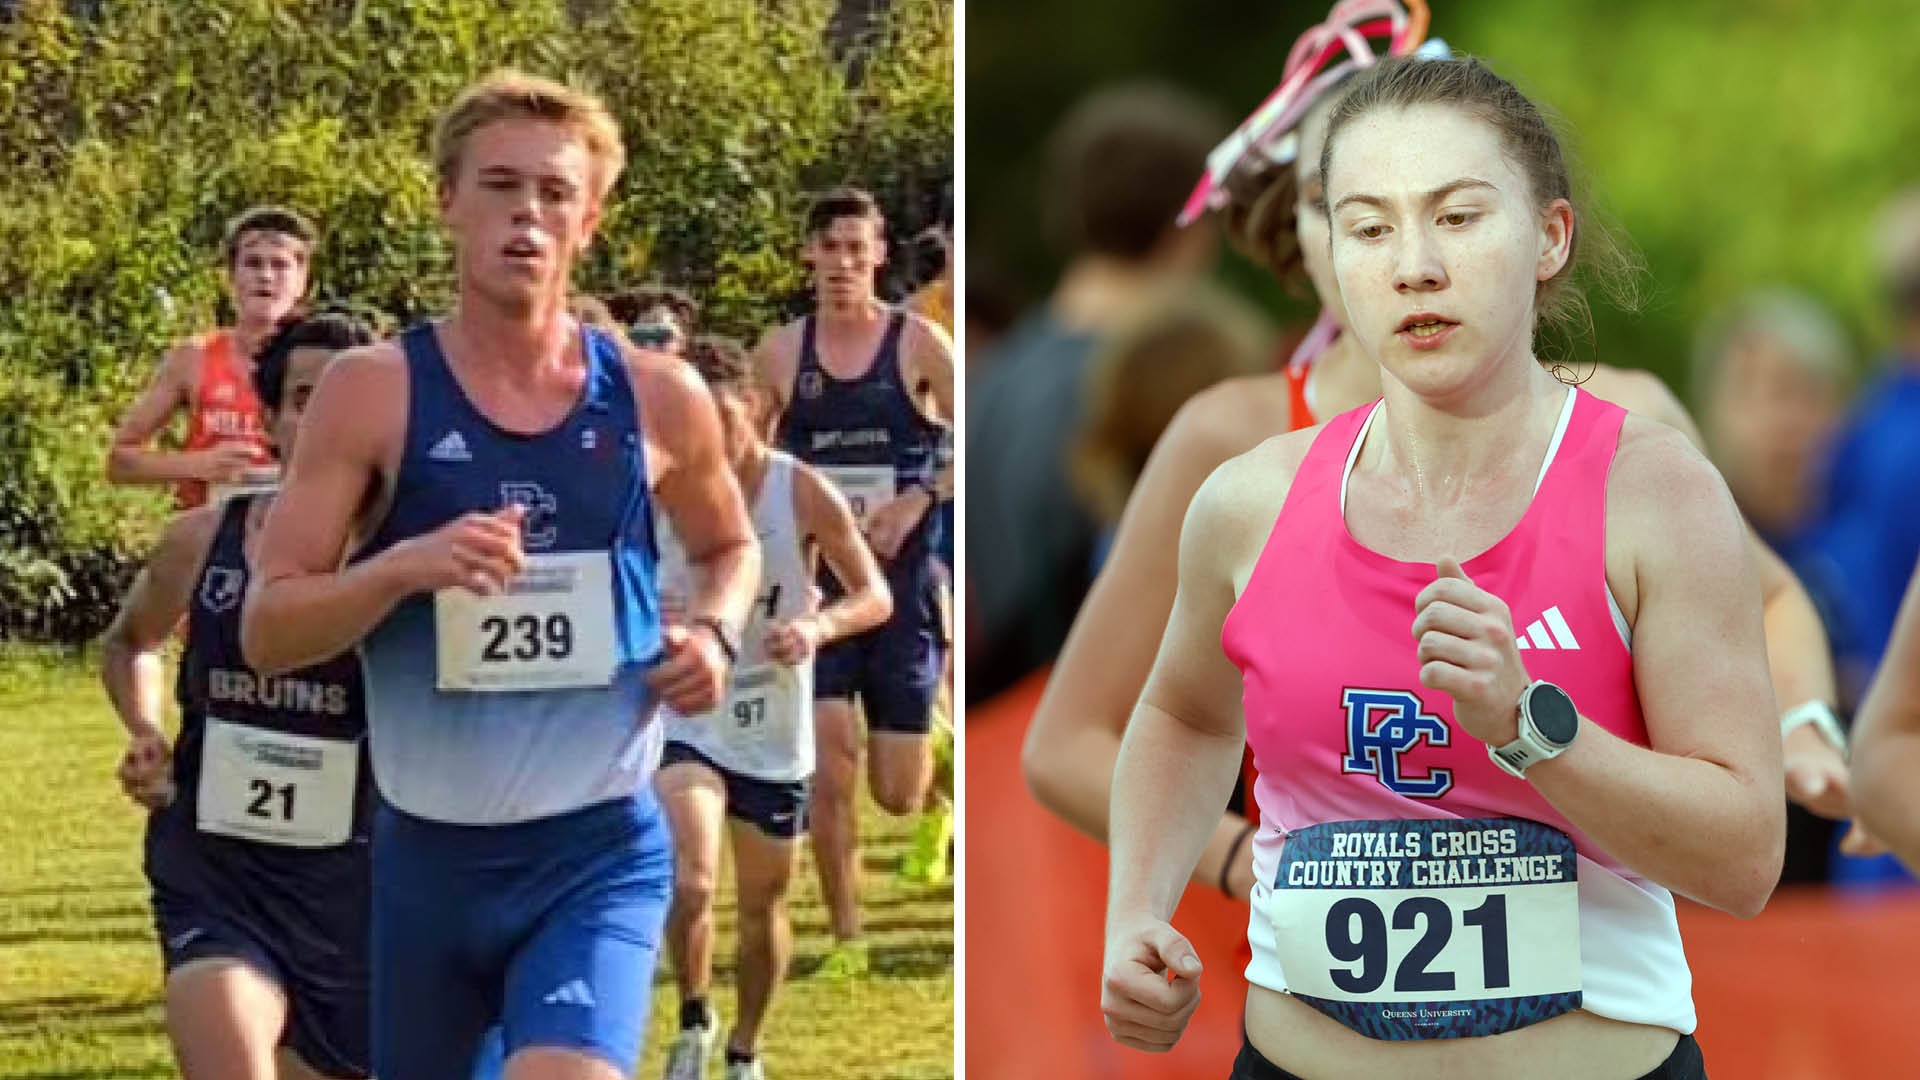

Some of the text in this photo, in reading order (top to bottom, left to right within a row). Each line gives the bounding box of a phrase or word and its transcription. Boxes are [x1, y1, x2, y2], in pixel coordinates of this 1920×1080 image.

[480, 613, 573, 662] 239
[208, 667, 348, 715] BRUINS
[734, 697, 765, 728] 97
[1342, 686, 1455, 799] PC
[246, 778, 298, 821] 21
[1331, 829, 1517, 858] ROYALS CROSS
[1288, 855, 1563, 886] COUNTRY CHALLENGE
[1324, 893, 1511, 994] 921
